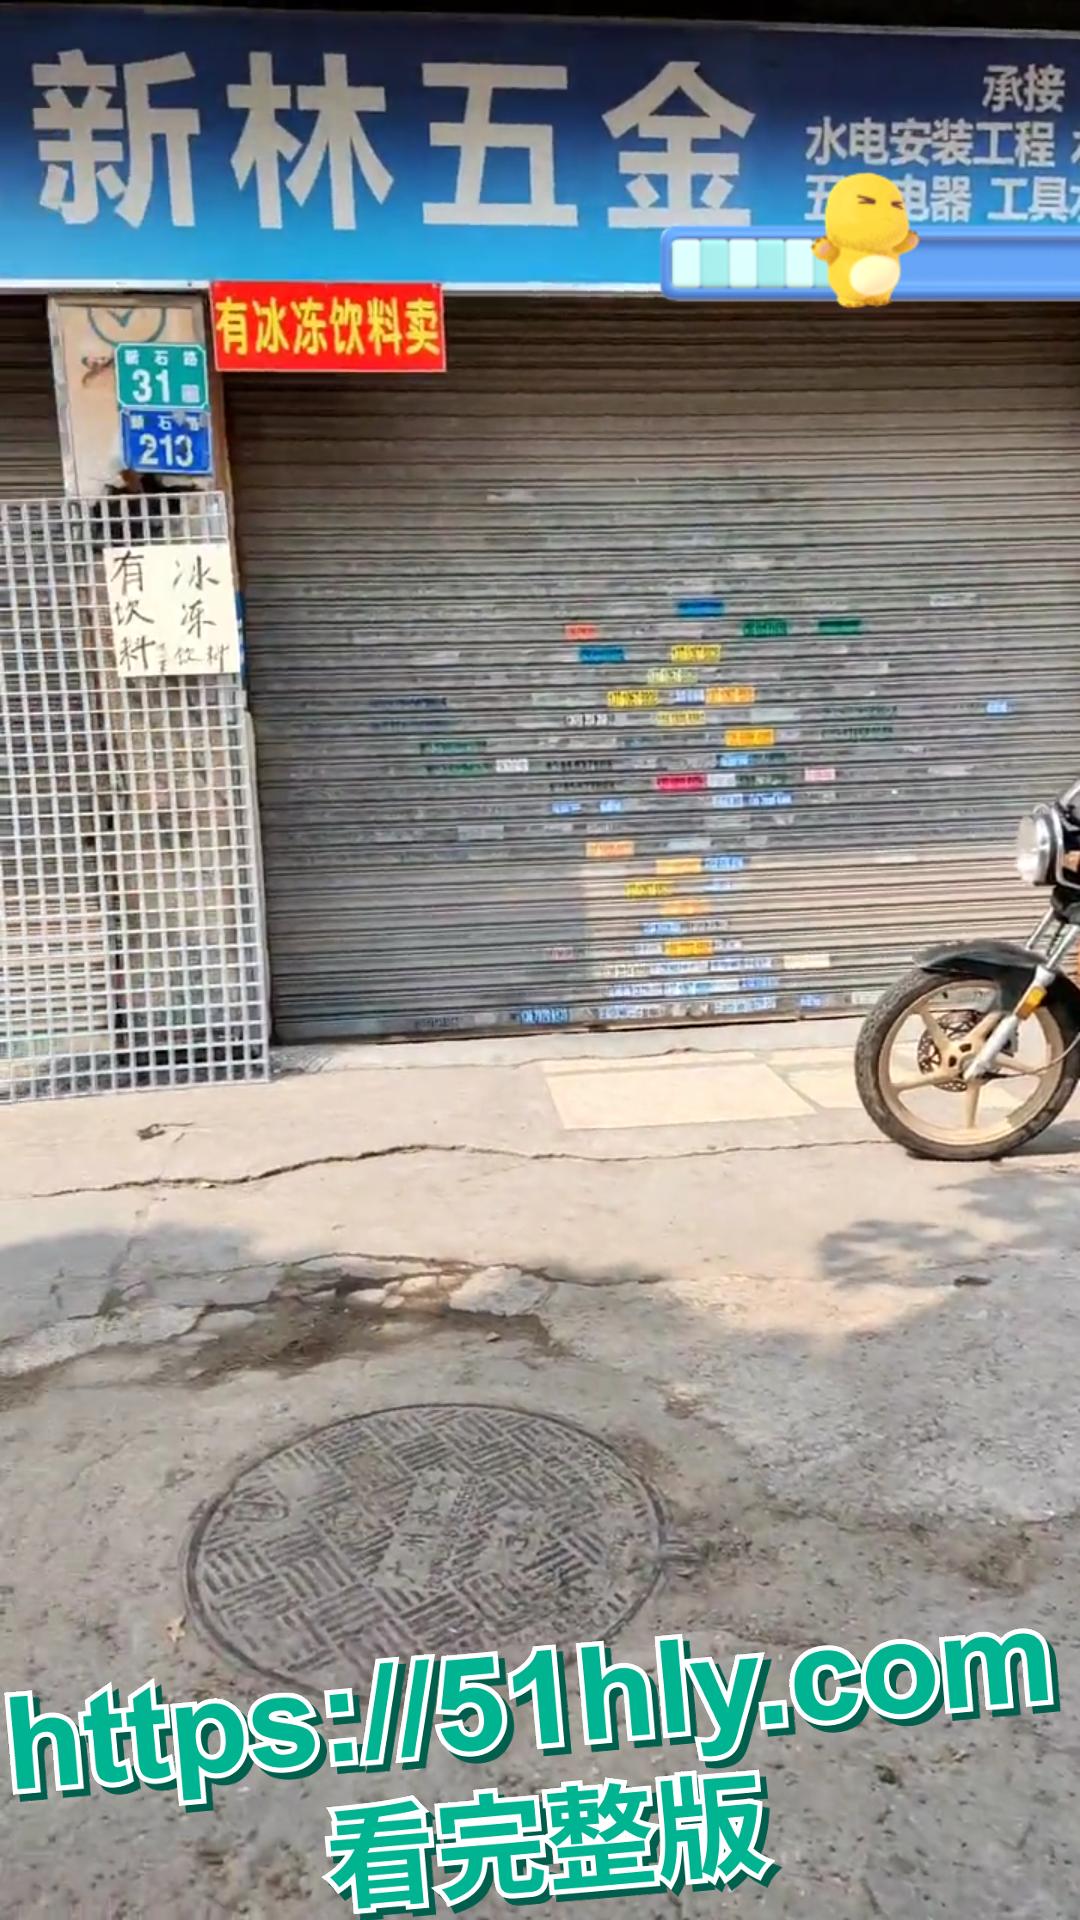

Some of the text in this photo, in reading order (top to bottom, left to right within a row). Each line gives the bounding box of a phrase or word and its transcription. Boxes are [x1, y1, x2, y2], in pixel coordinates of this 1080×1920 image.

[982, 64, 1066, 113] 承接
[32, 49, 756, 229] 新林五金
[805, 116, 1056, 168] 水电安装工程
[804, 173, 972, 223] 五电器
[215, 296, 441, 357] 有冰冻饮料卖
[132, 368, 170, 403] 31
[139, 433, 194, 468] 213
